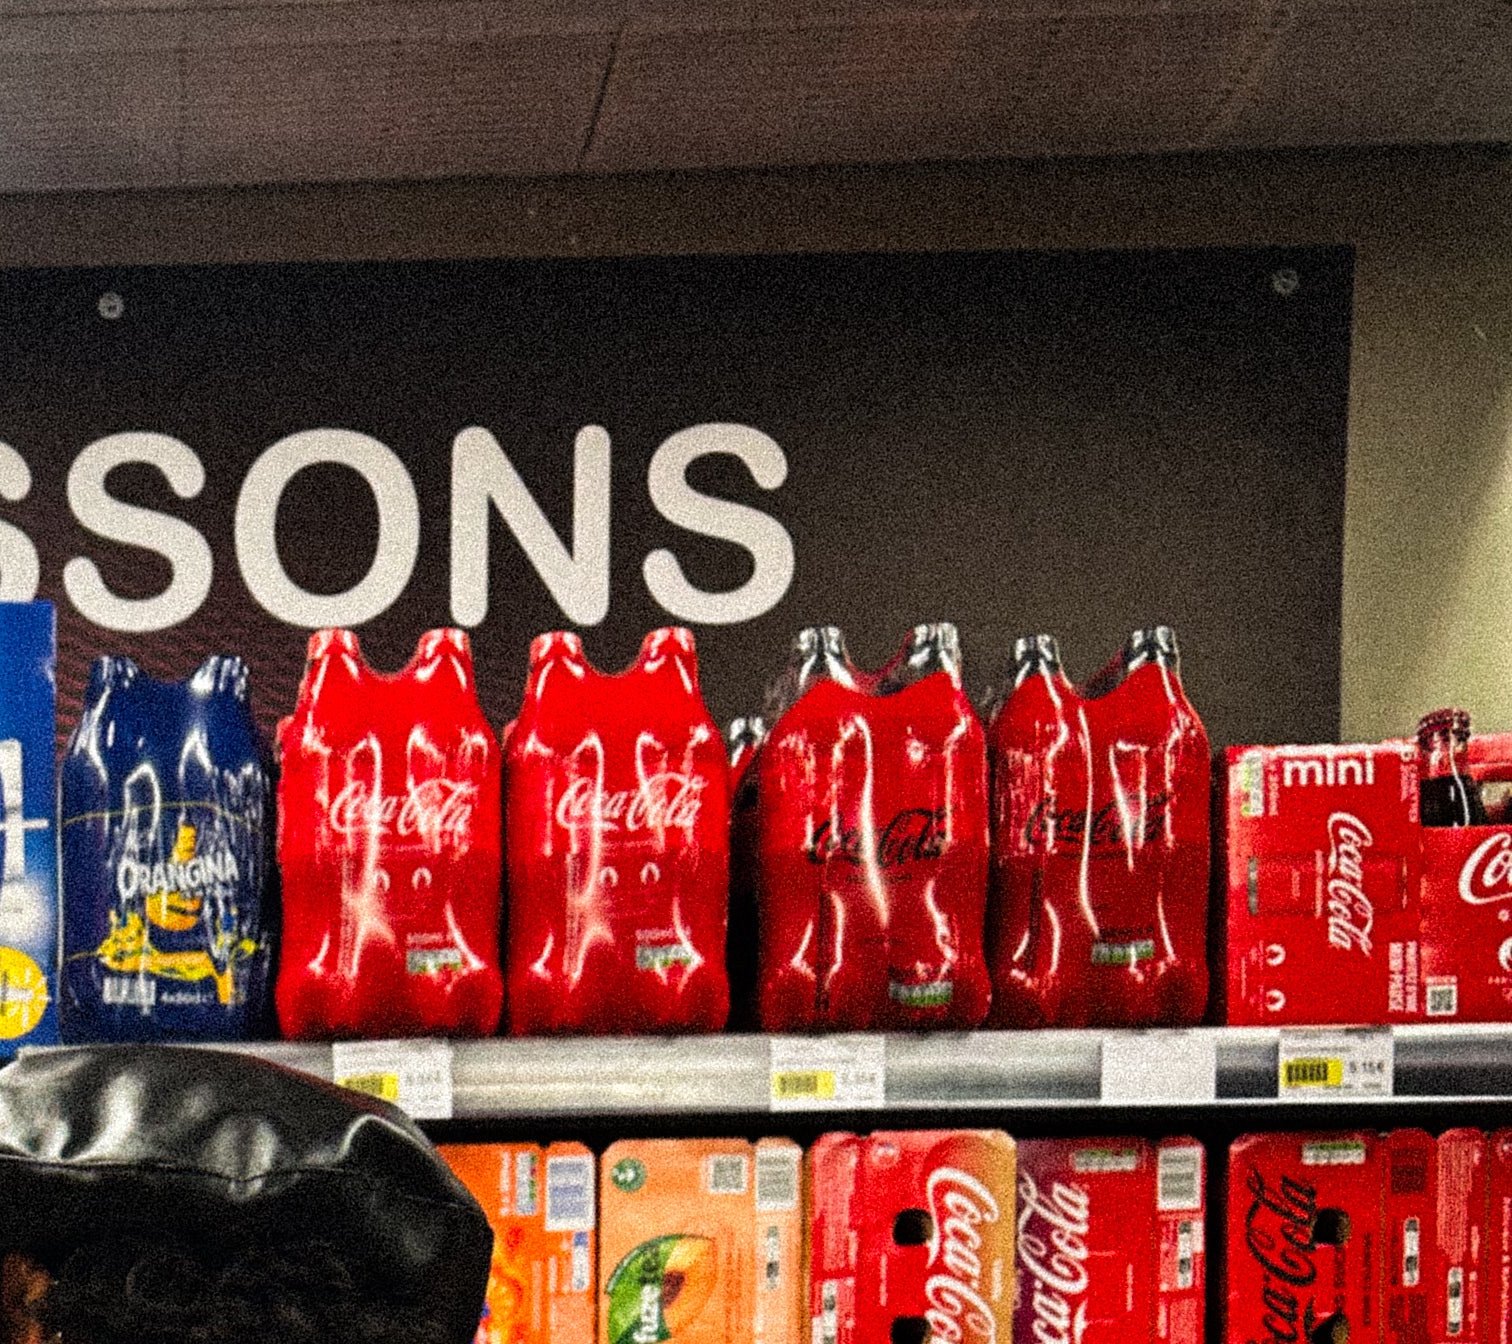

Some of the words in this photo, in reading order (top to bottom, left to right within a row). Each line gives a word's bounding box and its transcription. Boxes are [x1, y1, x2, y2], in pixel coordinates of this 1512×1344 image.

[1283, 752, 1374, 787] mini
[118, 852, 238, 905] ORANGINA
[1326, 811, 1373, 956] Coca-Cola
